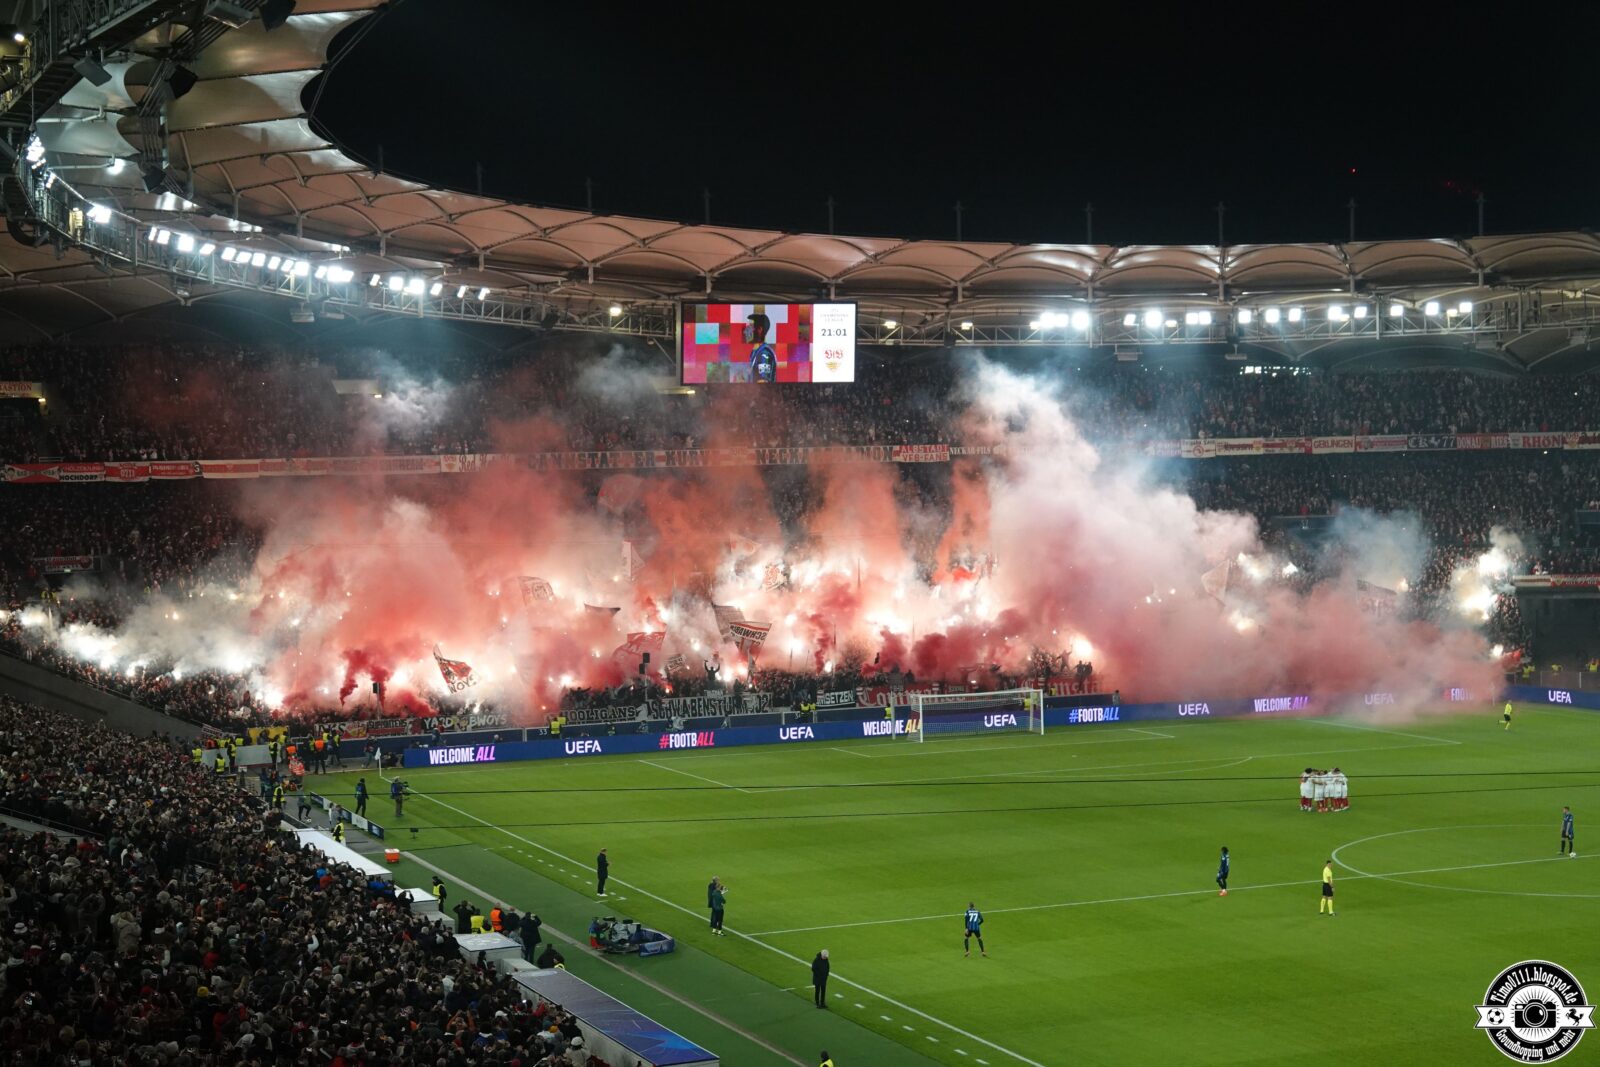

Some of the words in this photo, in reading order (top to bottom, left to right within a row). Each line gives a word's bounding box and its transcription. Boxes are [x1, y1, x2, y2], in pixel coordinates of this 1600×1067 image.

[821, 328, 847, 337] 21:01
[0, 383, 32, 392] ASTION
[1364, 693, 1395, 705] UEFA
[1548, 690, 1572, 704] UEFA
[1178, 703, 1210, 716] UEFA
[1254, 697, 1291, 712] WELCOME
[984, 714, 1017, 727] UEFA
[1068, 706, 1120, 723] #FOOTBALL
[658, 731, 715, 749] #FOOTBALL
[779, 726, 814, 740] UEFA
[565, 740, 602, 754] UEFA
[429, 747, 475, 765] WELCOME
[475, 745, 496, 762] ALL
[968, 912, 979, 922] 77
